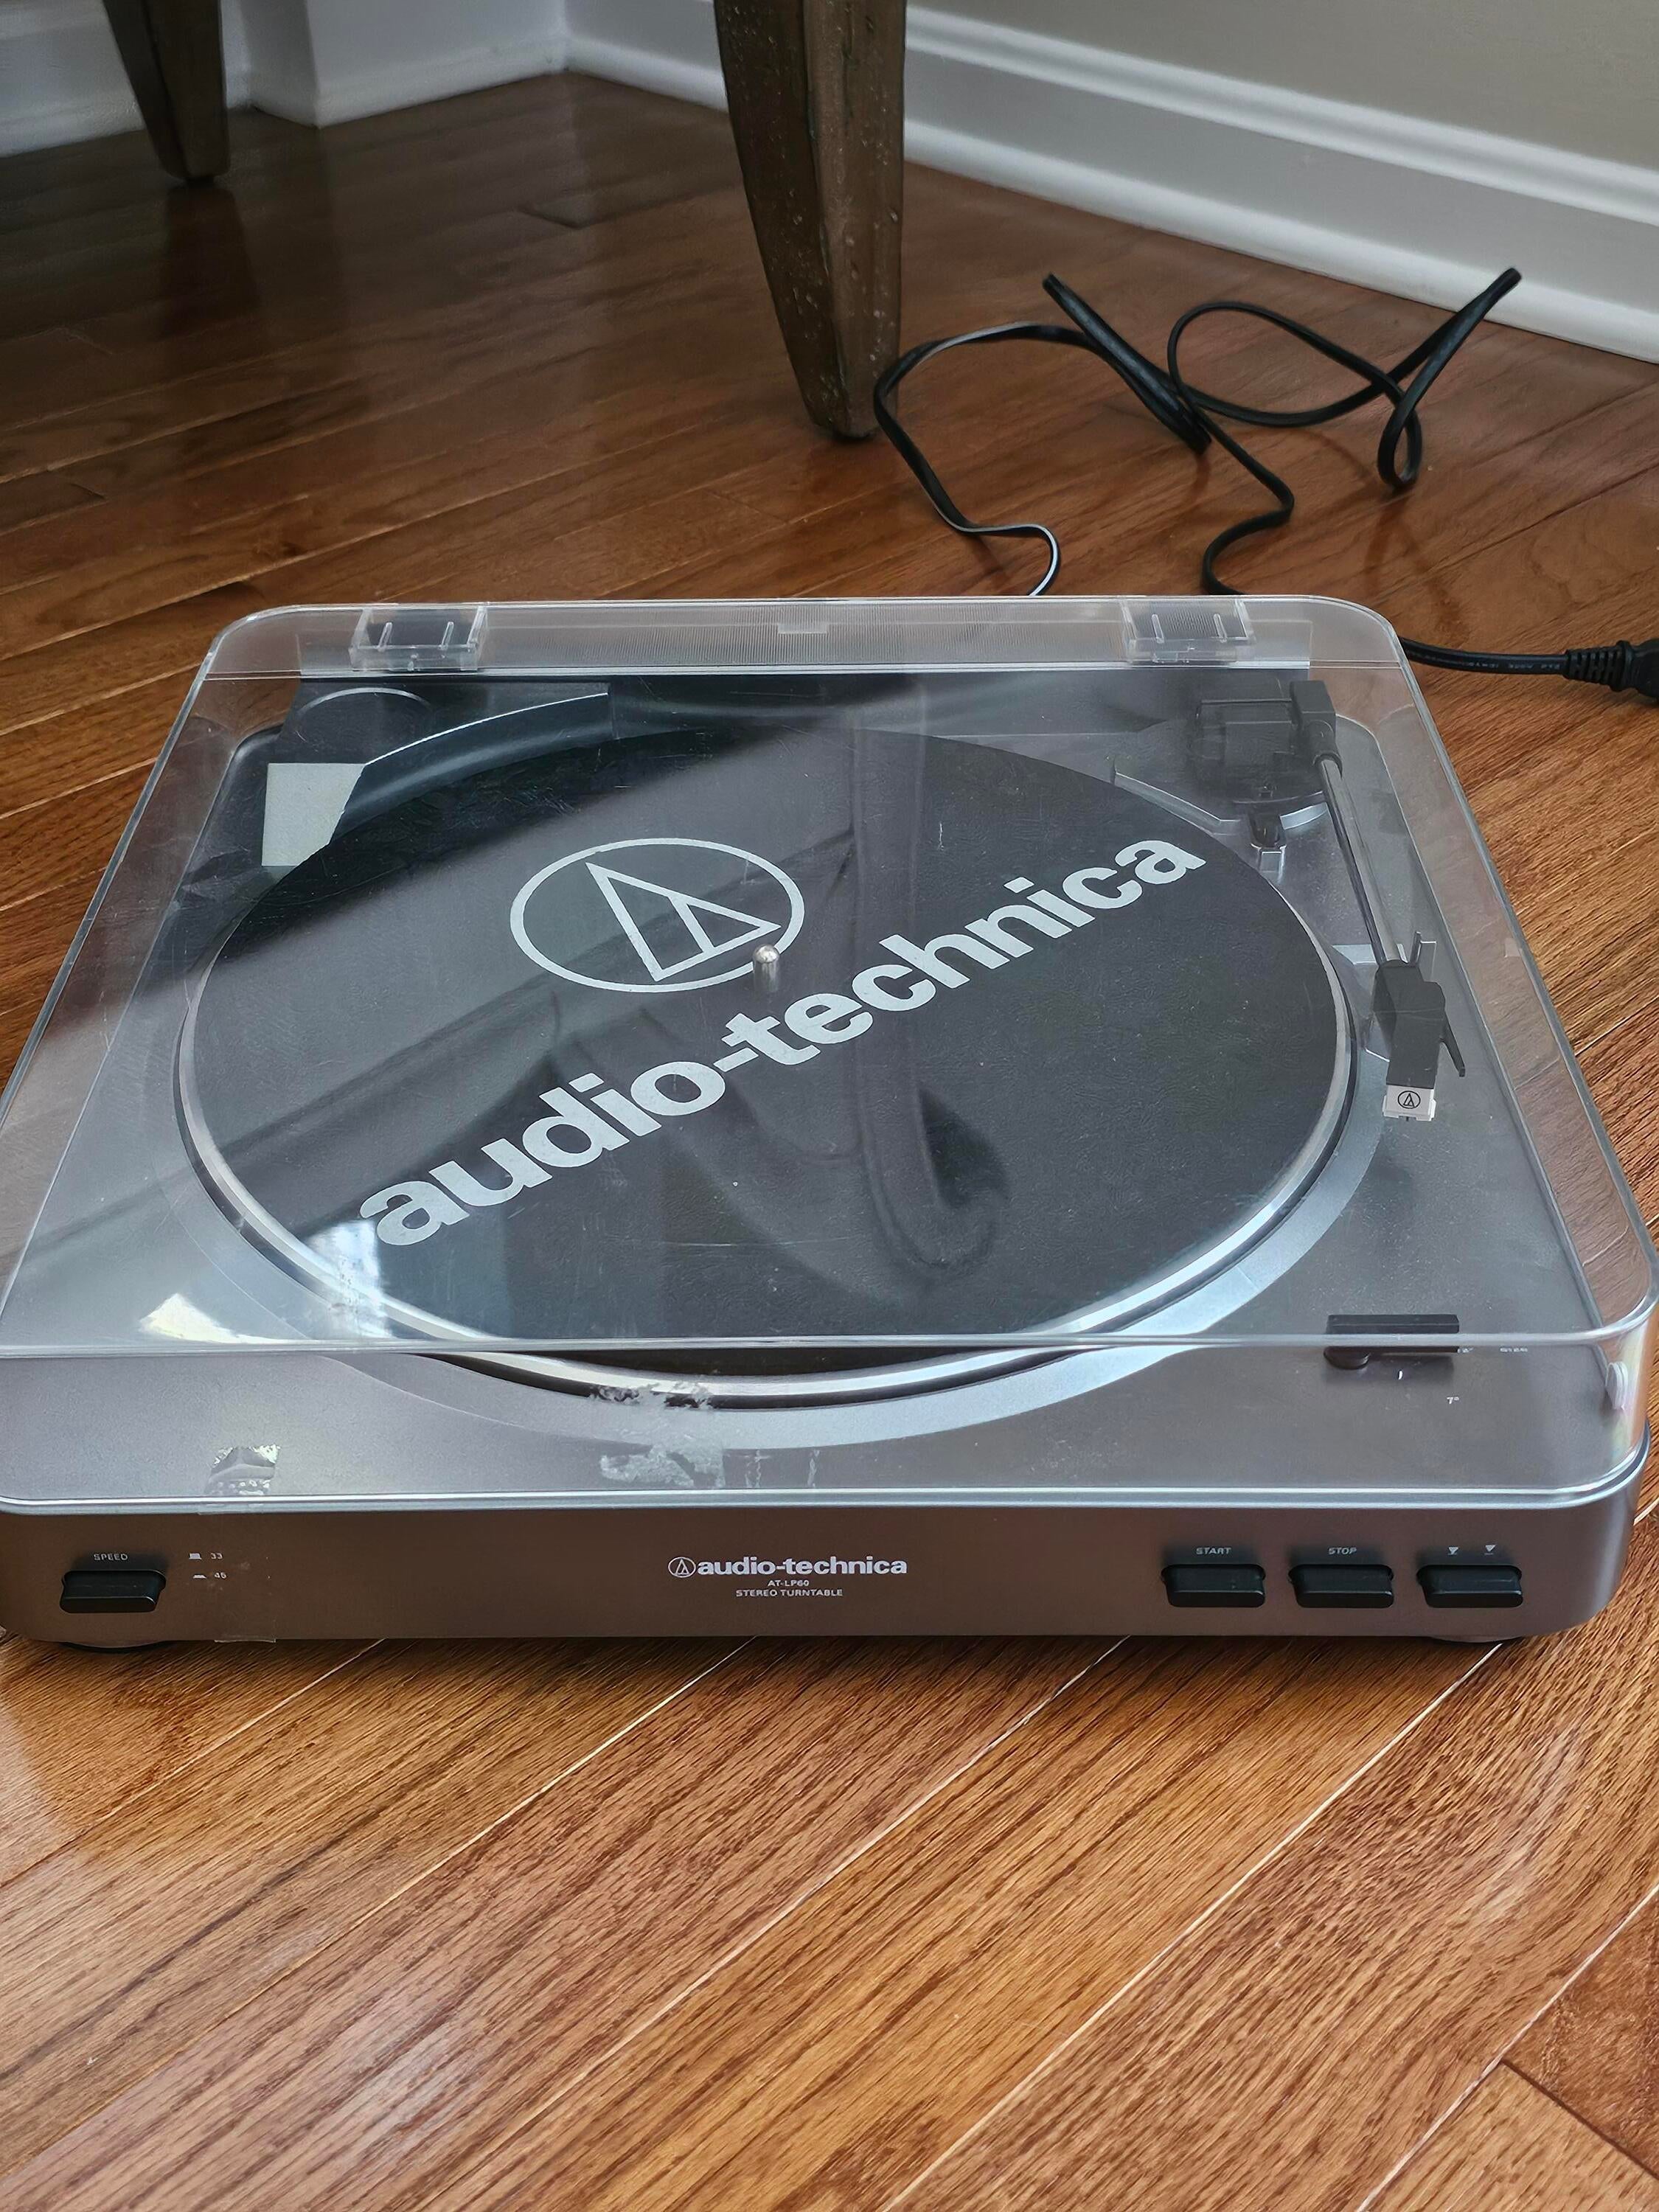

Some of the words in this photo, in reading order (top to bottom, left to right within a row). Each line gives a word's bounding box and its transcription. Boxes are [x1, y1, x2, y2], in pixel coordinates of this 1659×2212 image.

[359, 838, 1207, 1246] audio-technica
[1195, 1547, 1232, 1555] START
[1328, 1547, 1357, 1555] STOP
[697, 1555, 908, 1576] audio-technica
[735, 1589, 778, 1597] STEREO
[779, 1589, 844, 1597] TURNTABLE
